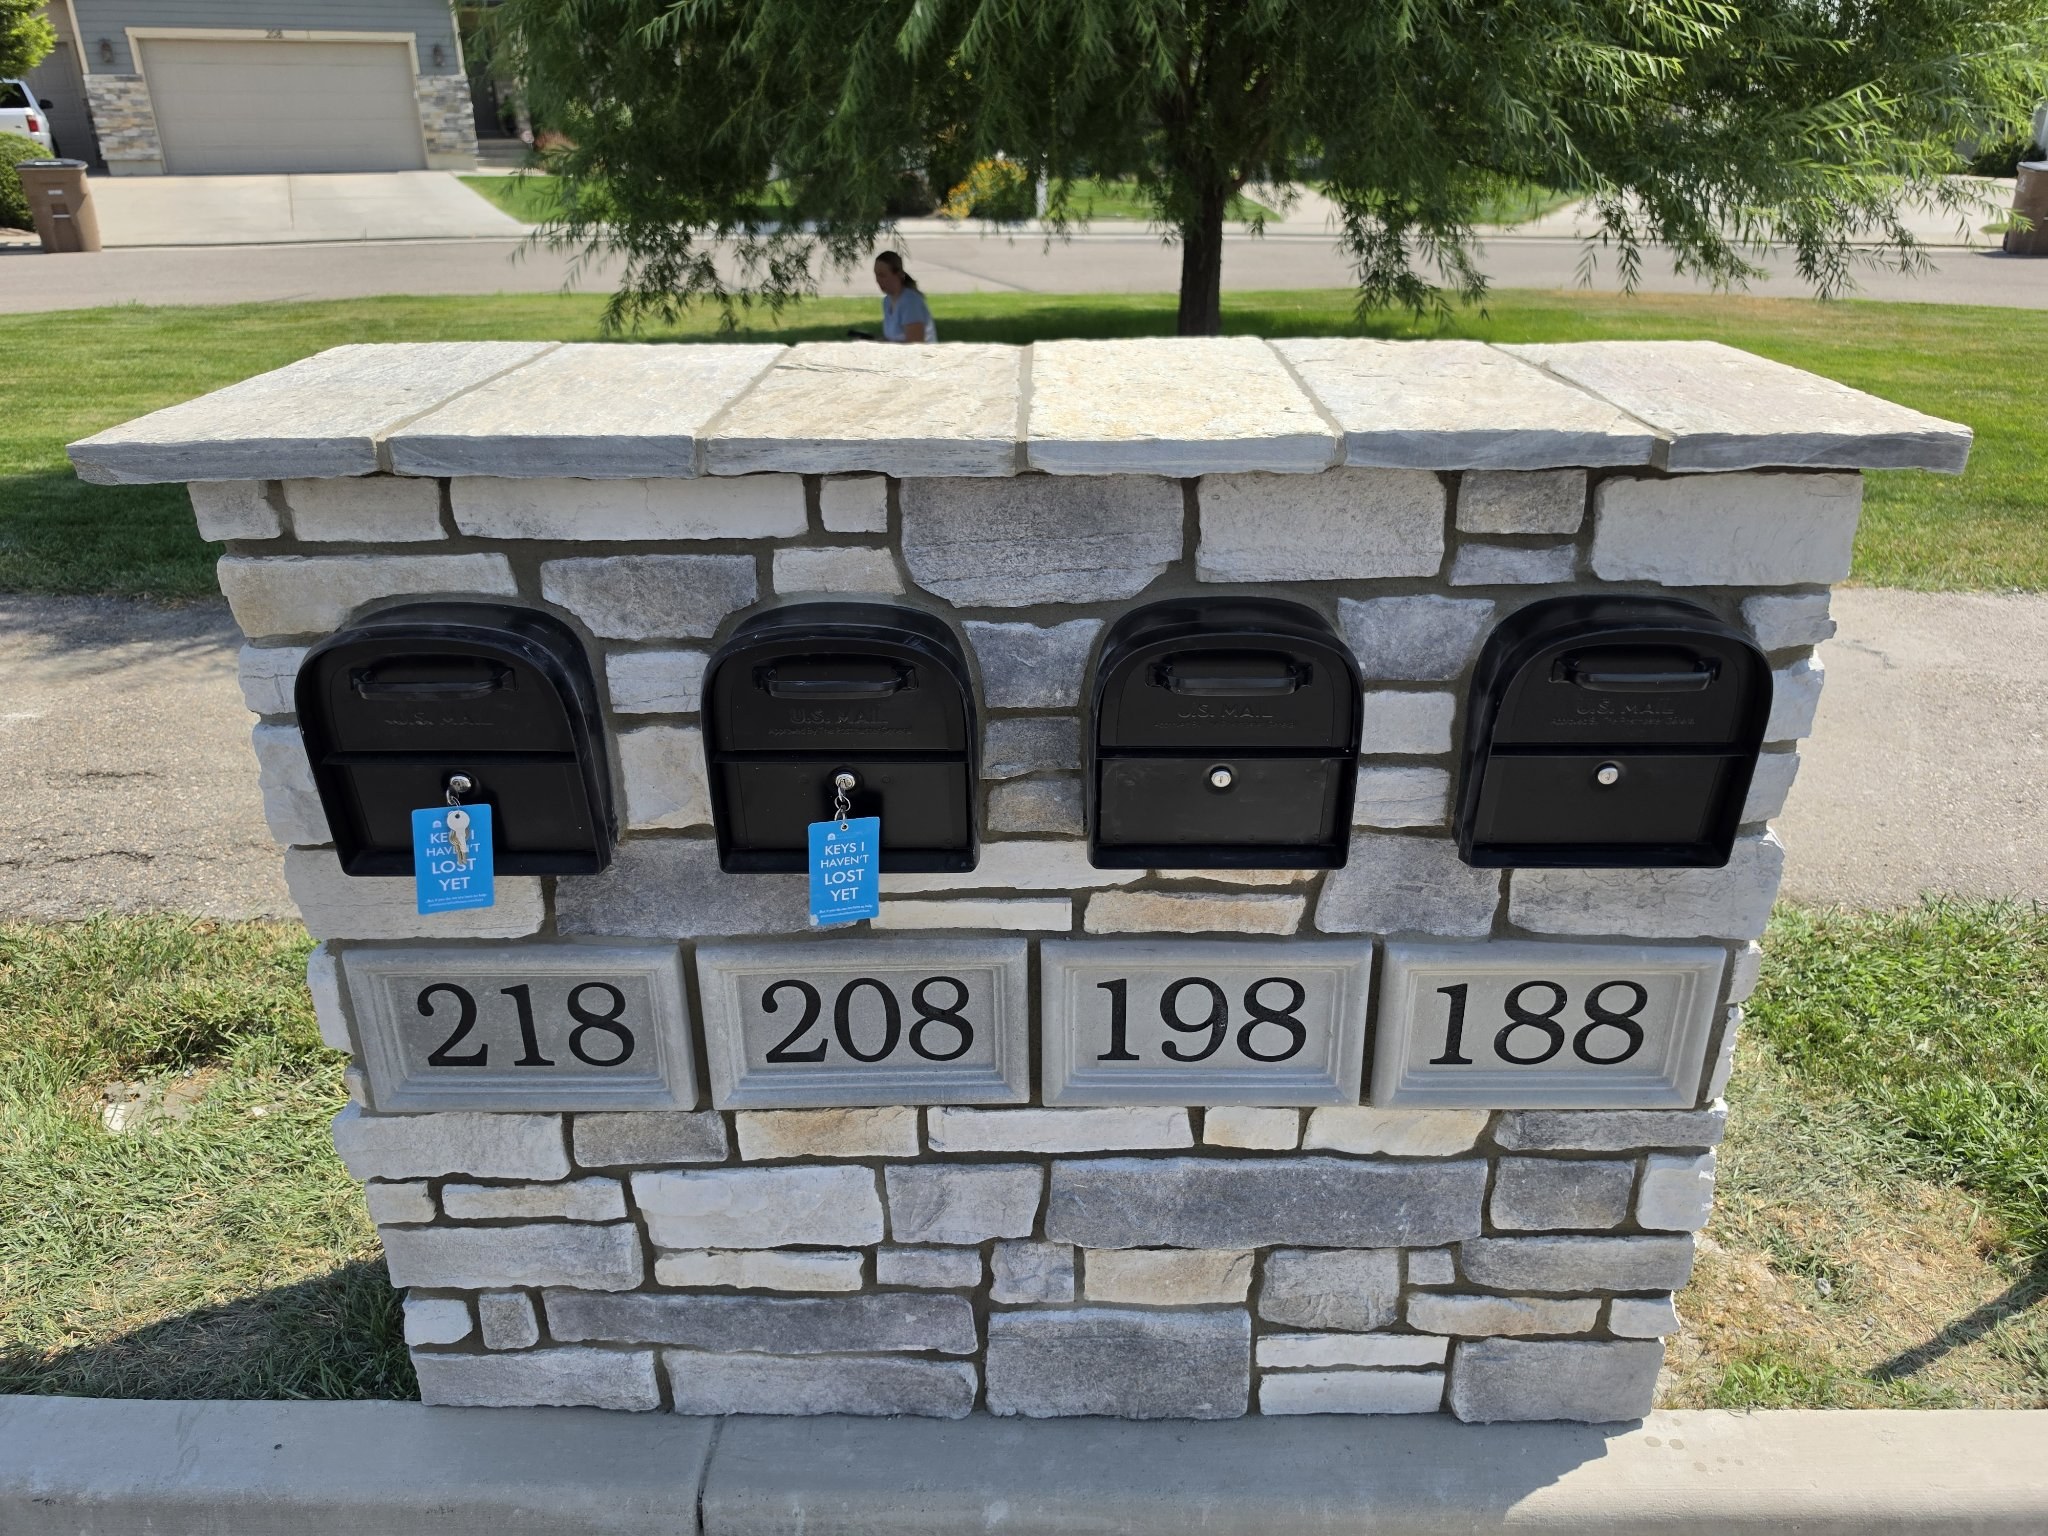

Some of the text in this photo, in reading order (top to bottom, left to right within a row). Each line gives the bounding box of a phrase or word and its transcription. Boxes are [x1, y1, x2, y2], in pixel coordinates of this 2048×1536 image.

[825, 841, 865, 856] KEYS I
[432, 858, 477, 875] LOST
[820, 854, 869, 869] HAVEN'T
[438, 876, 471, 892] YET
[824, 868, 865, 886] LOST
[830, 886, 859, 902] YET
[417, 982, 635, 1068] 218
[762, 976, 974, 1064] 208
[1096, 976, 1307, 1063] 198
[1430, 980, 1648, 1066] 188
